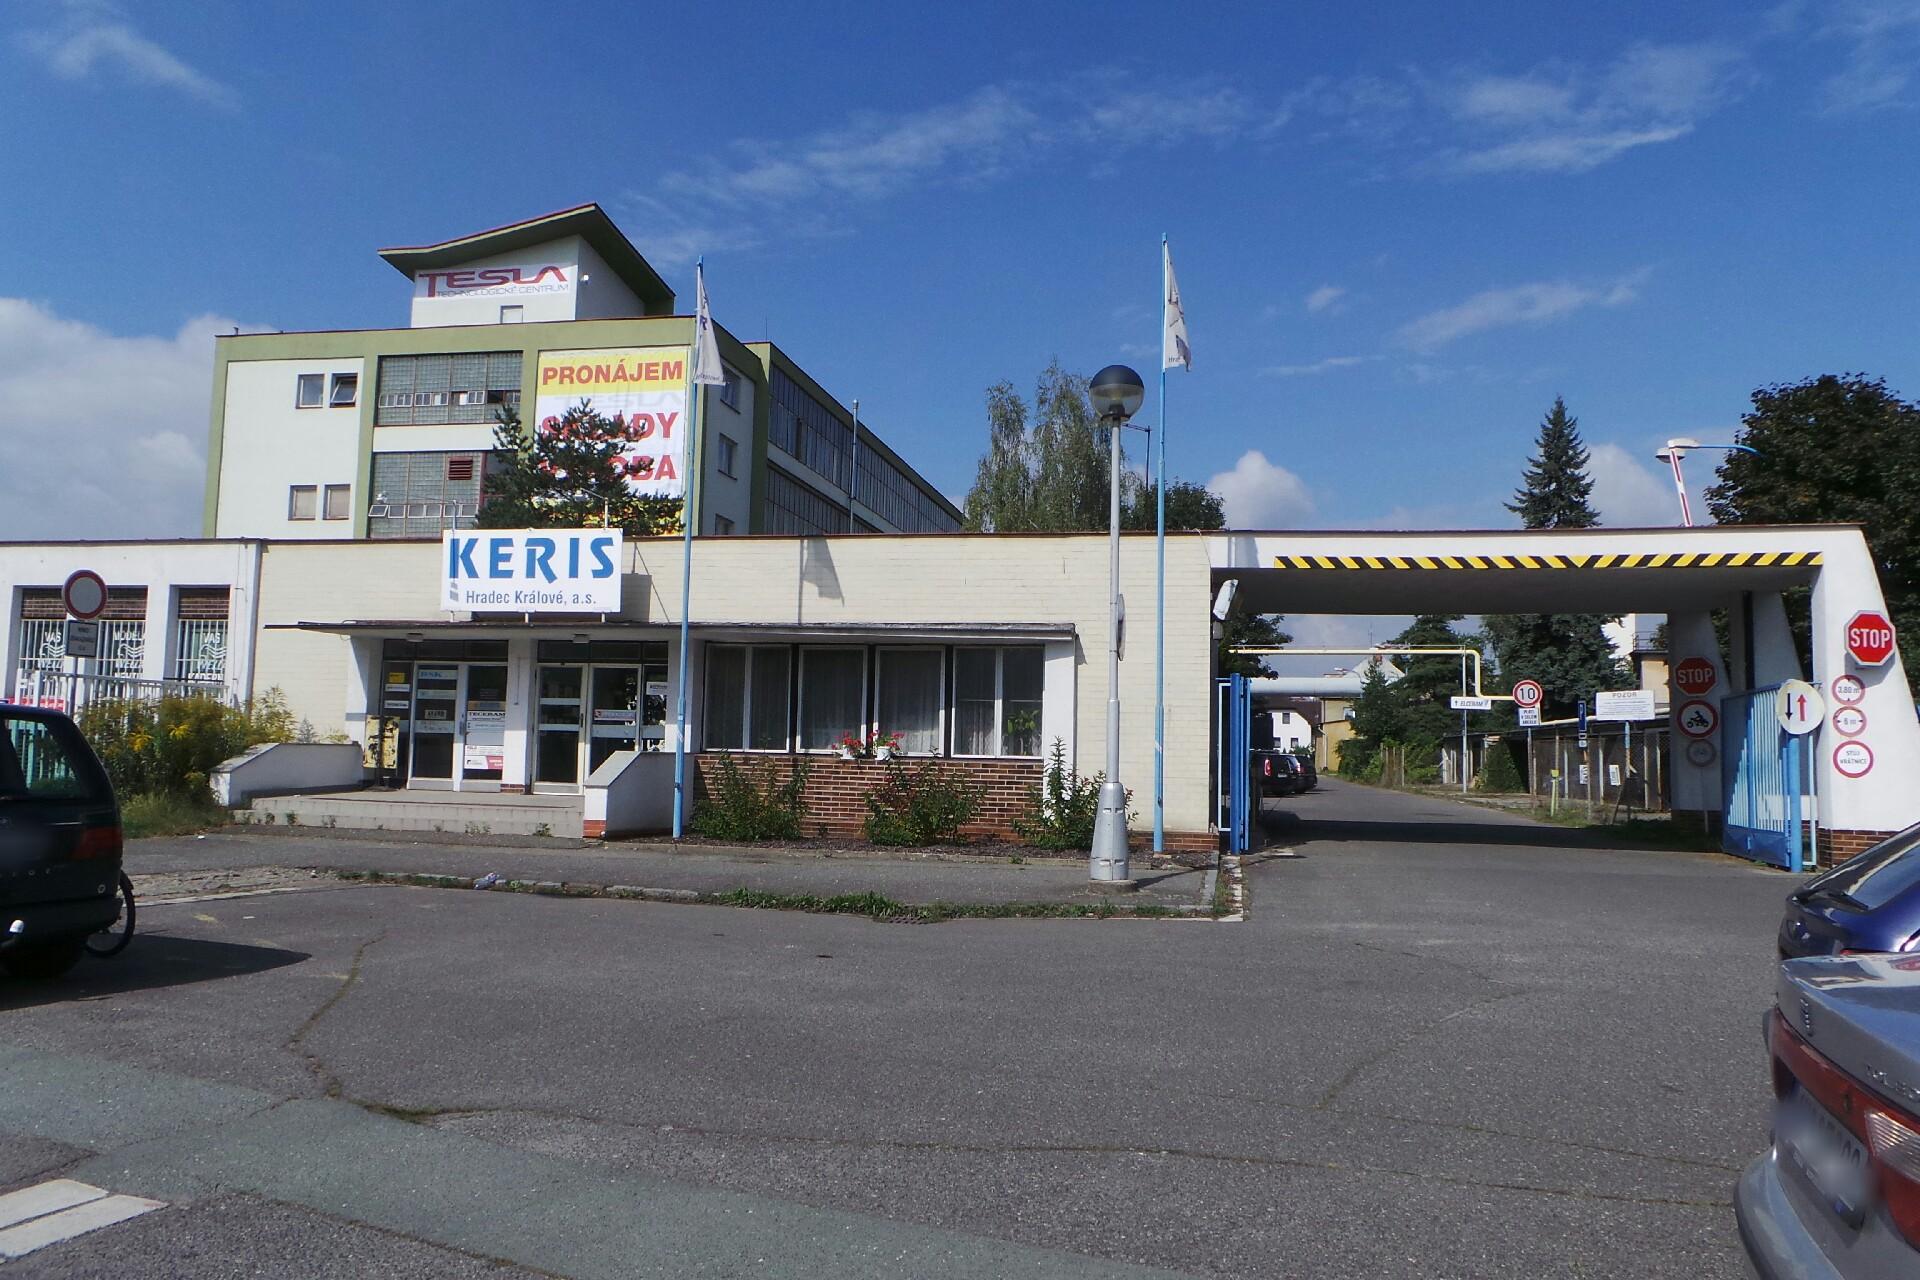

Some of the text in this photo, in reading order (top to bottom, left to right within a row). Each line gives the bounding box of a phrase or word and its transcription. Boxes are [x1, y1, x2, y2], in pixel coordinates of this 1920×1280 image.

[418, 265, 568, 297] TESLA
[518, 284, 569, 295] CENTRUM
[542, 358, 683, 386] PRONÁJEM
[448, 536, 615, 584] KERIS
[466, 590, 510, 604] Hradec
[514, 589, 568, 606] Králové,
[1850, 628, 1891, 649] STOP
[1677, 669, 1714, 684] STOP
[1519, 687, 1536, 701] 10
